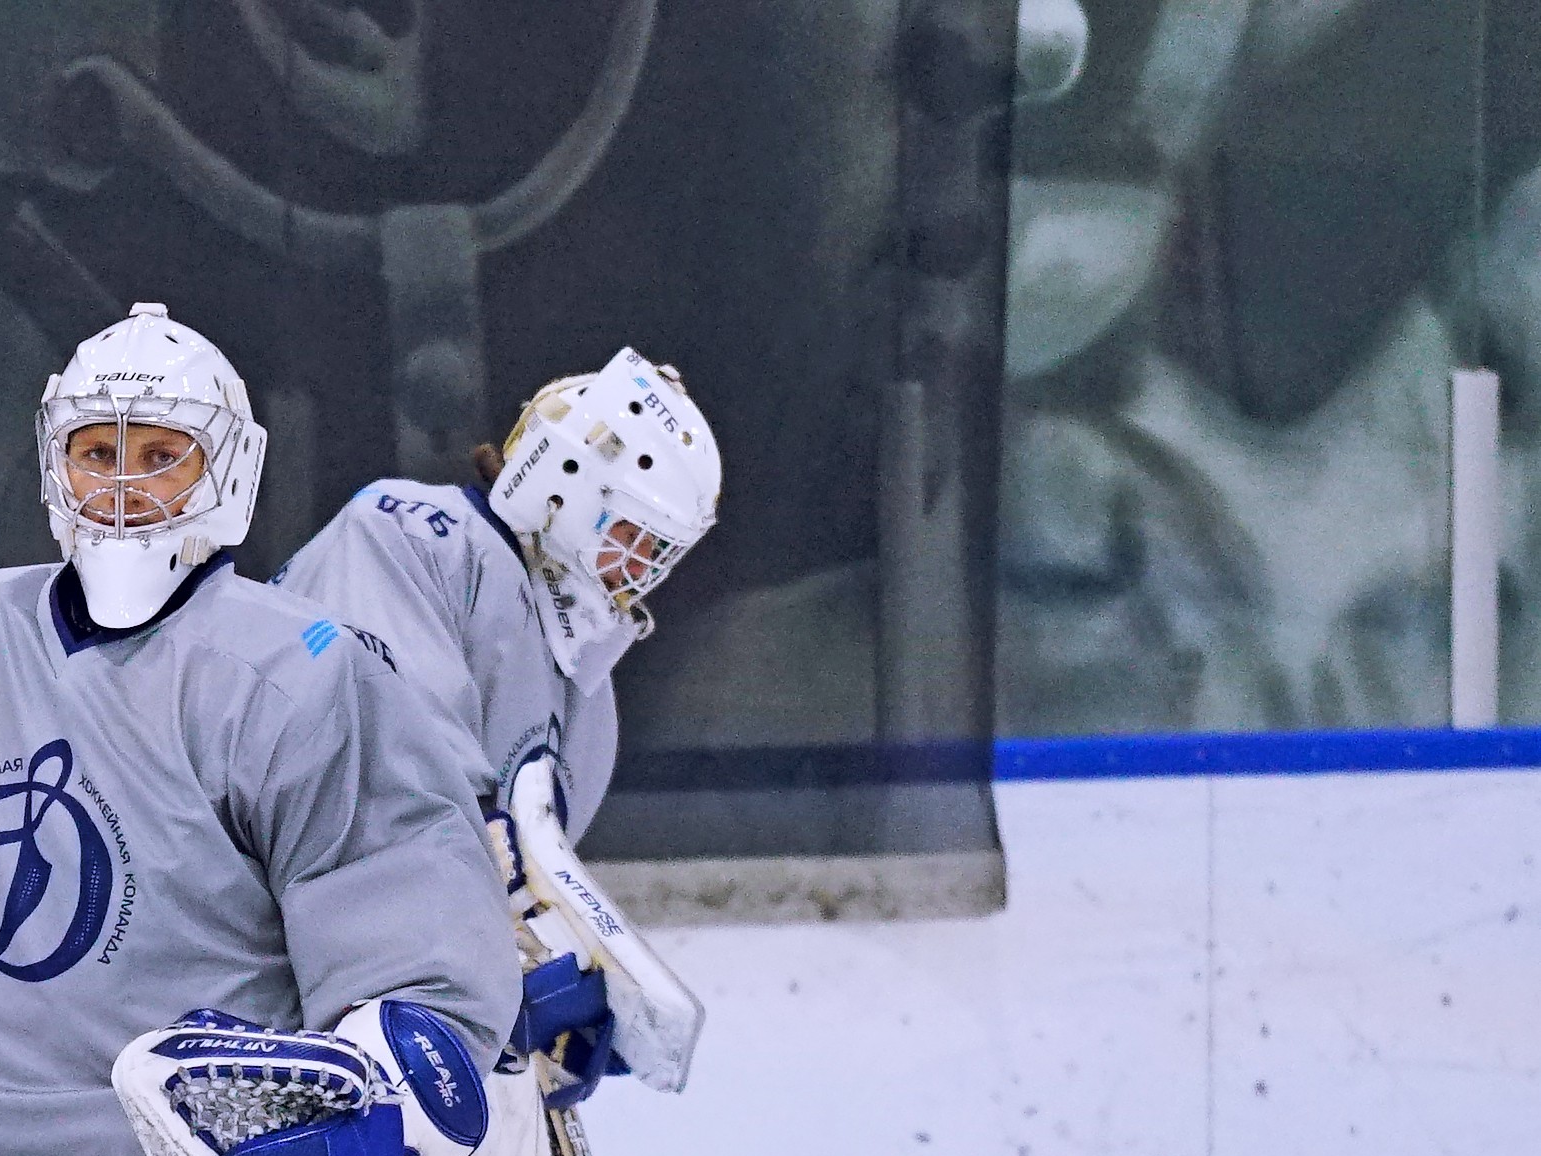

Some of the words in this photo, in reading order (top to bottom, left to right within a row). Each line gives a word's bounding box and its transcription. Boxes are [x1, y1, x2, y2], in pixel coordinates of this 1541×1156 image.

[644, 392, 679, 433] ВТБ
[77, 772, 132, 866] ХОККЕЙНАЯ
[96, 872, 137, 966] КОМАНДА
[554, 869, 625, 936] INTENSE
